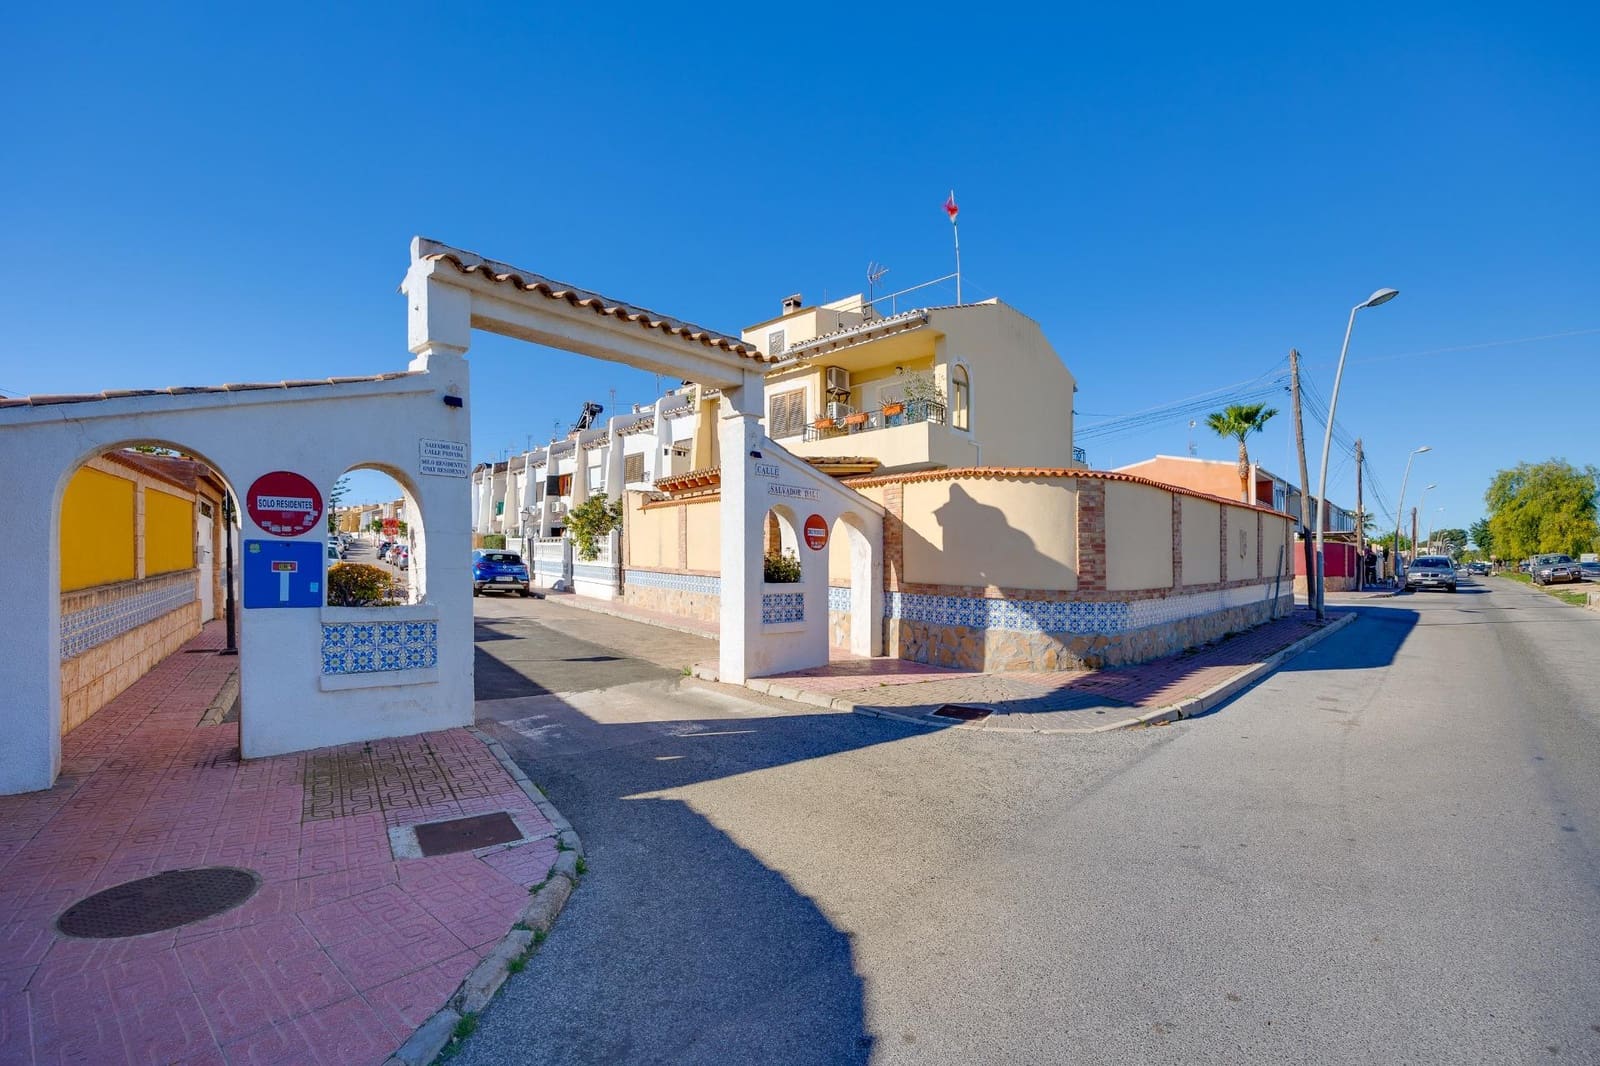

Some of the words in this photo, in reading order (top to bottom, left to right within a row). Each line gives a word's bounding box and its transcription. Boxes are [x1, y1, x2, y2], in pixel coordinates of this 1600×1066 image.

[757, 466, 779, 475] CALLE
[770, 485, 801, 496] SALVADOR
[258, 498, 275, 508] SOLO
[276, 499, 313, 510] RESIDENTES
